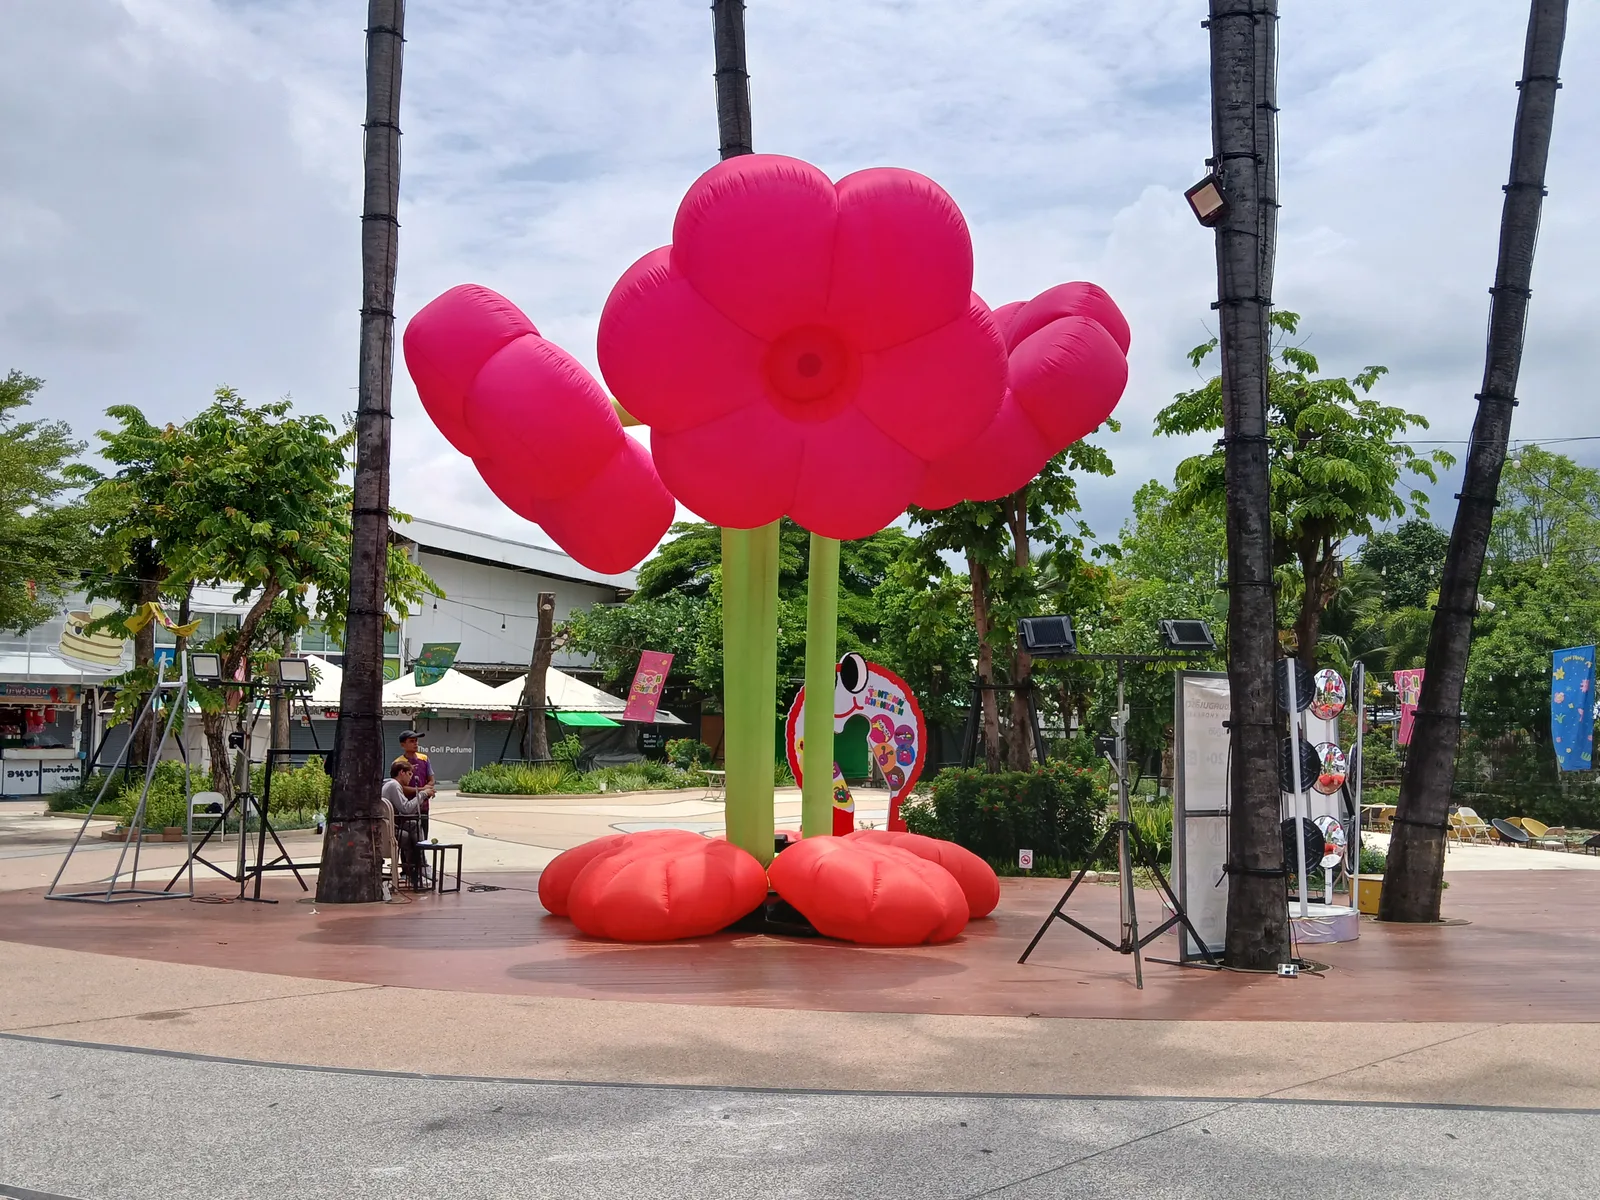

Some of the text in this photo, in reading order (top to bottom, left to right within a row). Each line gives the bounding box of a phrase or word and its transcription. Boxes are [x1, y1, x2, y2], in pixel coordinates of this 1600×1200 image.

[418, 745, 429, 753] The
[445, 746, 472, 754] Perfume
[7, 770, 39, 782] อนุชา
